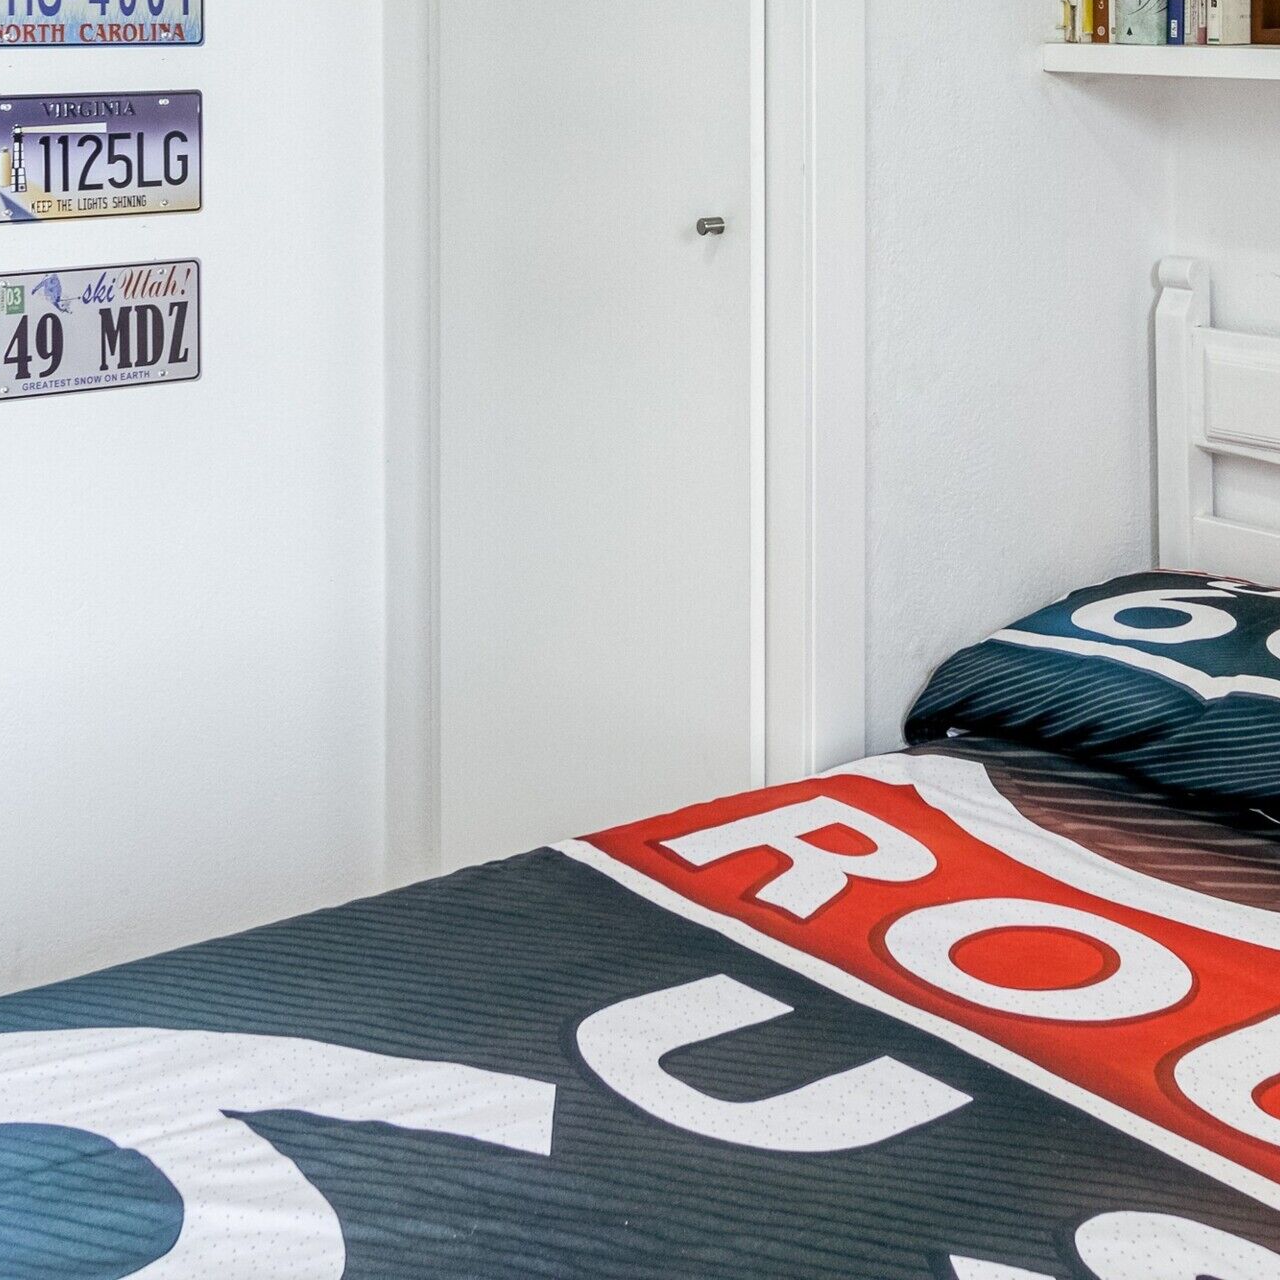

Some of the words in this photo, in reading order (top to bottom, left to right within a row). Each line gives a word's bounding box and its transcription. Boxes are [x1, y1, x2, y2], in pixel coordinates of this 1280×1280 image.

[79, 23, 185, 42] CAROLINA
[42, 101, 136, 118] VIRGINIA
[38, 130, 189, 193] 1125LG
[31, 200, 52, 213] KEEP
[57, 199, 72, 211] THE
[78, 197, 108, 210] LIGHTS
[112, 195, 147, 209] SHINING
[82, 271, 115, 305] ski
[119, 265, 191, 299] Utah!
[7, 290, 20, 305] 03
[98, 300, 189, 371] MDZ
[22, 379, 71, 391] GREATEST
[74, 375, 103, 385] SNOW
[105, 374, 118, 382] ON
[120, 370, 150, 381] EARTH
